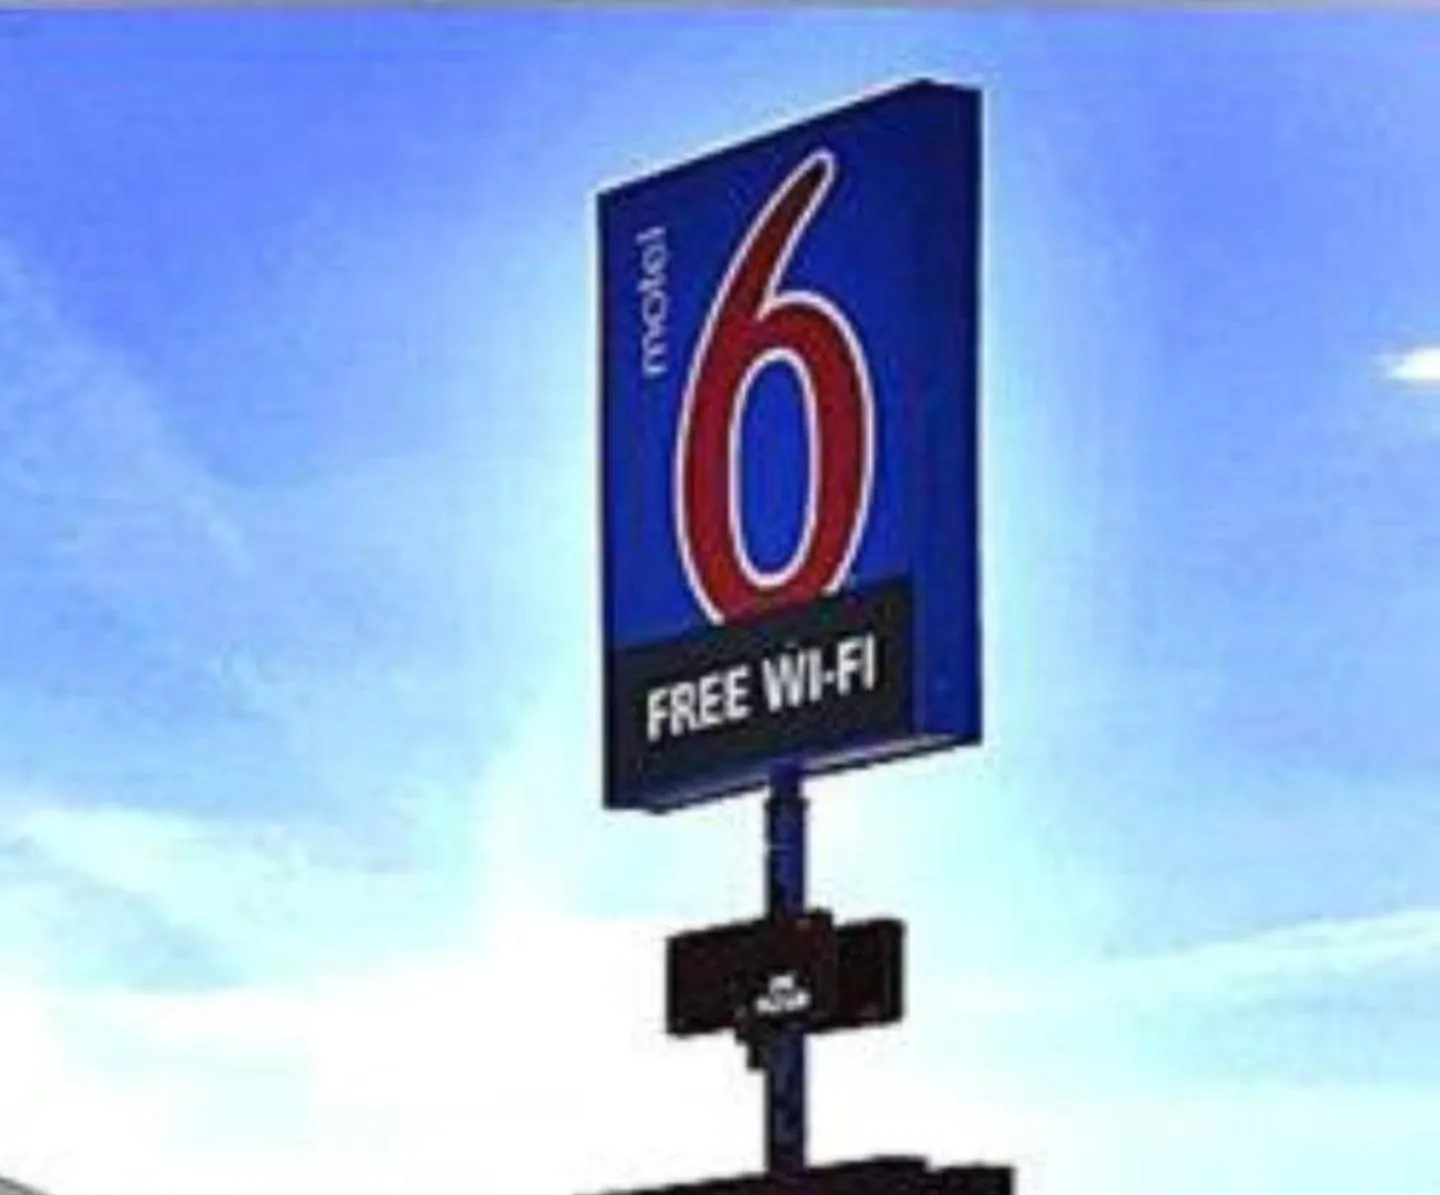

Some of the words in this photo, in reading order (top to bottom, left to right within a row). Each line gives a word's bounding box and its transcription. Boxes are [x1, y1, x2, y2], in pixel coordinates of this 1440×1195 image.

[640, 226, 668, 377] motel
[675, 149, 876, 625] 6
[645, 665, 753, 744] FREE
[760, 633, 877, 715] WI-FI
